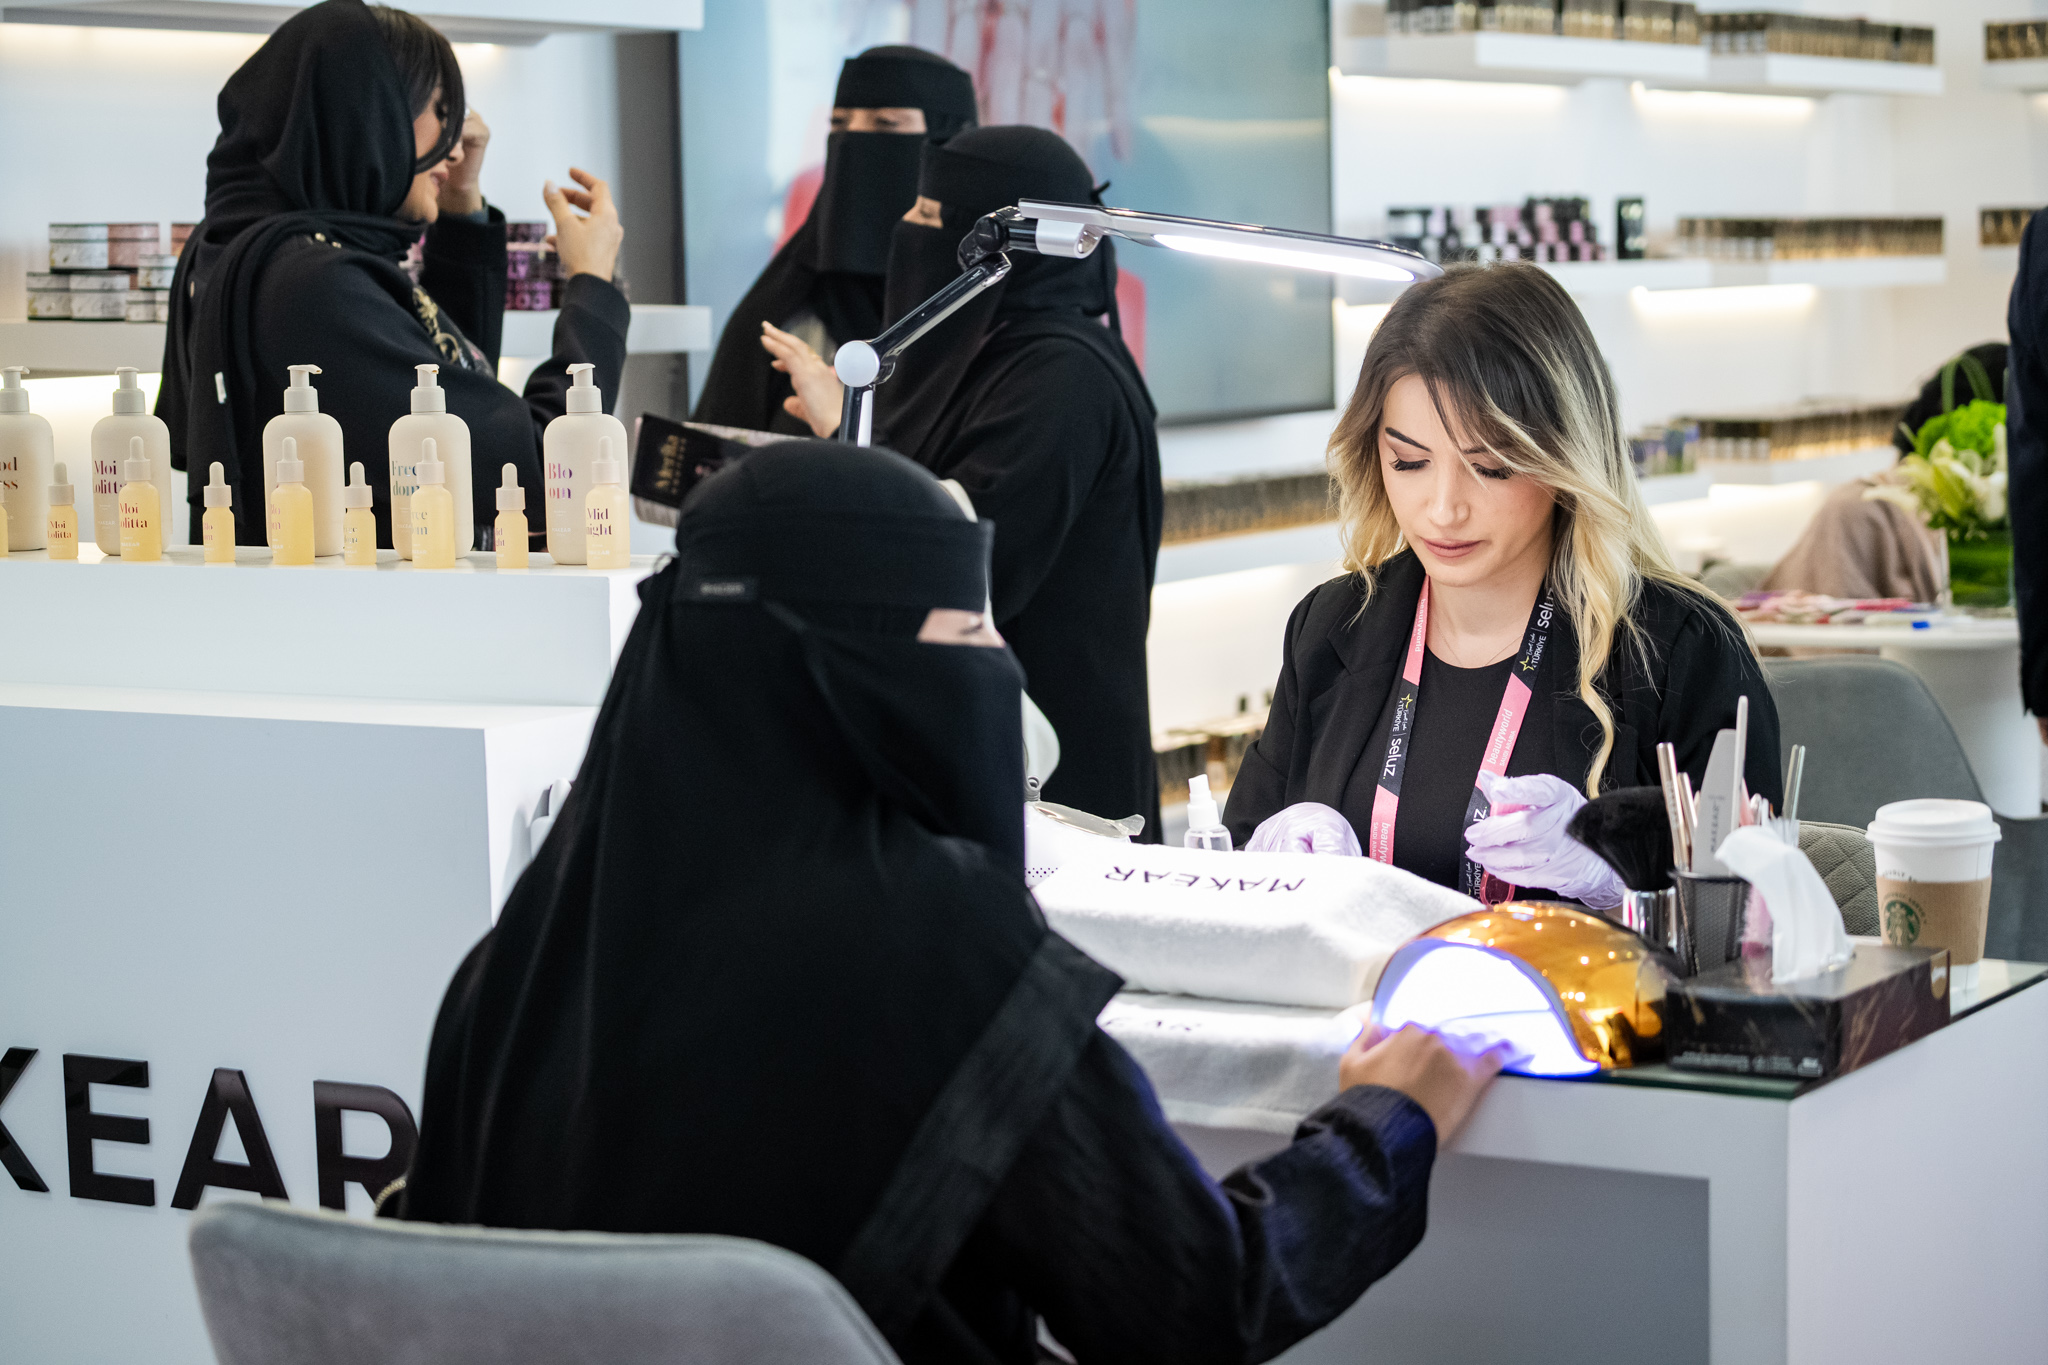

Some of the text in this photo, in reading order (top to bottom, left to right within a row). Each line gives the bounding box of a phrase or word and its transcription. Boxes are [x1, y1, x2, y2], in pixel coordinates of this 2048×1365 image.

[94, 460, 117, 475] Moi
[548, 462, 573, 479] Blo
[94, 479, 127, 494] olitt
[549, 487, 572, 499] om
[587, 507, 609, 520] Mid
[50, 520, 66, 529] Moi
[120, 517, 148, 529] olitta
[1414, 598, 1426, 652] beautyworld
[1486, 708, 1513, 765] beautyworld
[1378, 822, 1391, 864] beautyw
[1104, 865, 1306, 893] MAKEAR
